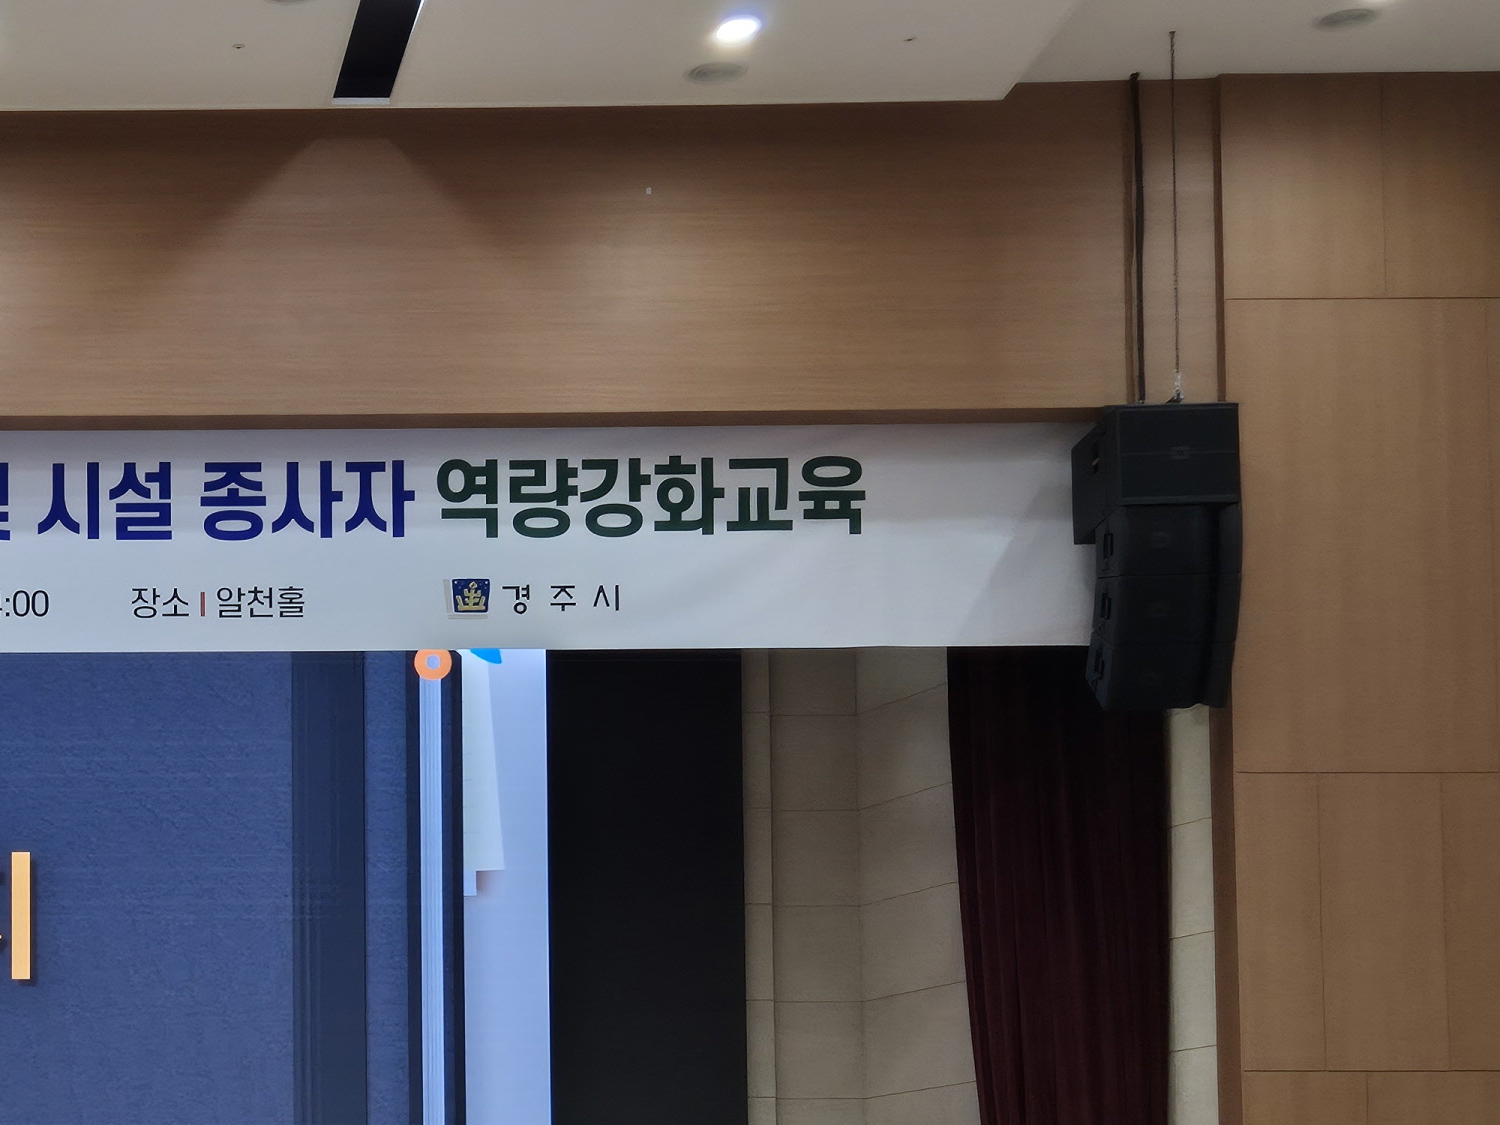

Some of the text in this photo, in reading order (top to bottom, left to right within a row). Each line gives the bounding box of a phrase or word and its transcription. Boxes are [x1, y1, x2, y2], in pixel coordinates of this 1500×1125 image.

[37, 461, 173, 541] 시설
[200, 459, 416, 541] 종사자
[436, 454, 867, 539] 역량강화교육
[131, 585, 306, 619] 장소 알천홀
